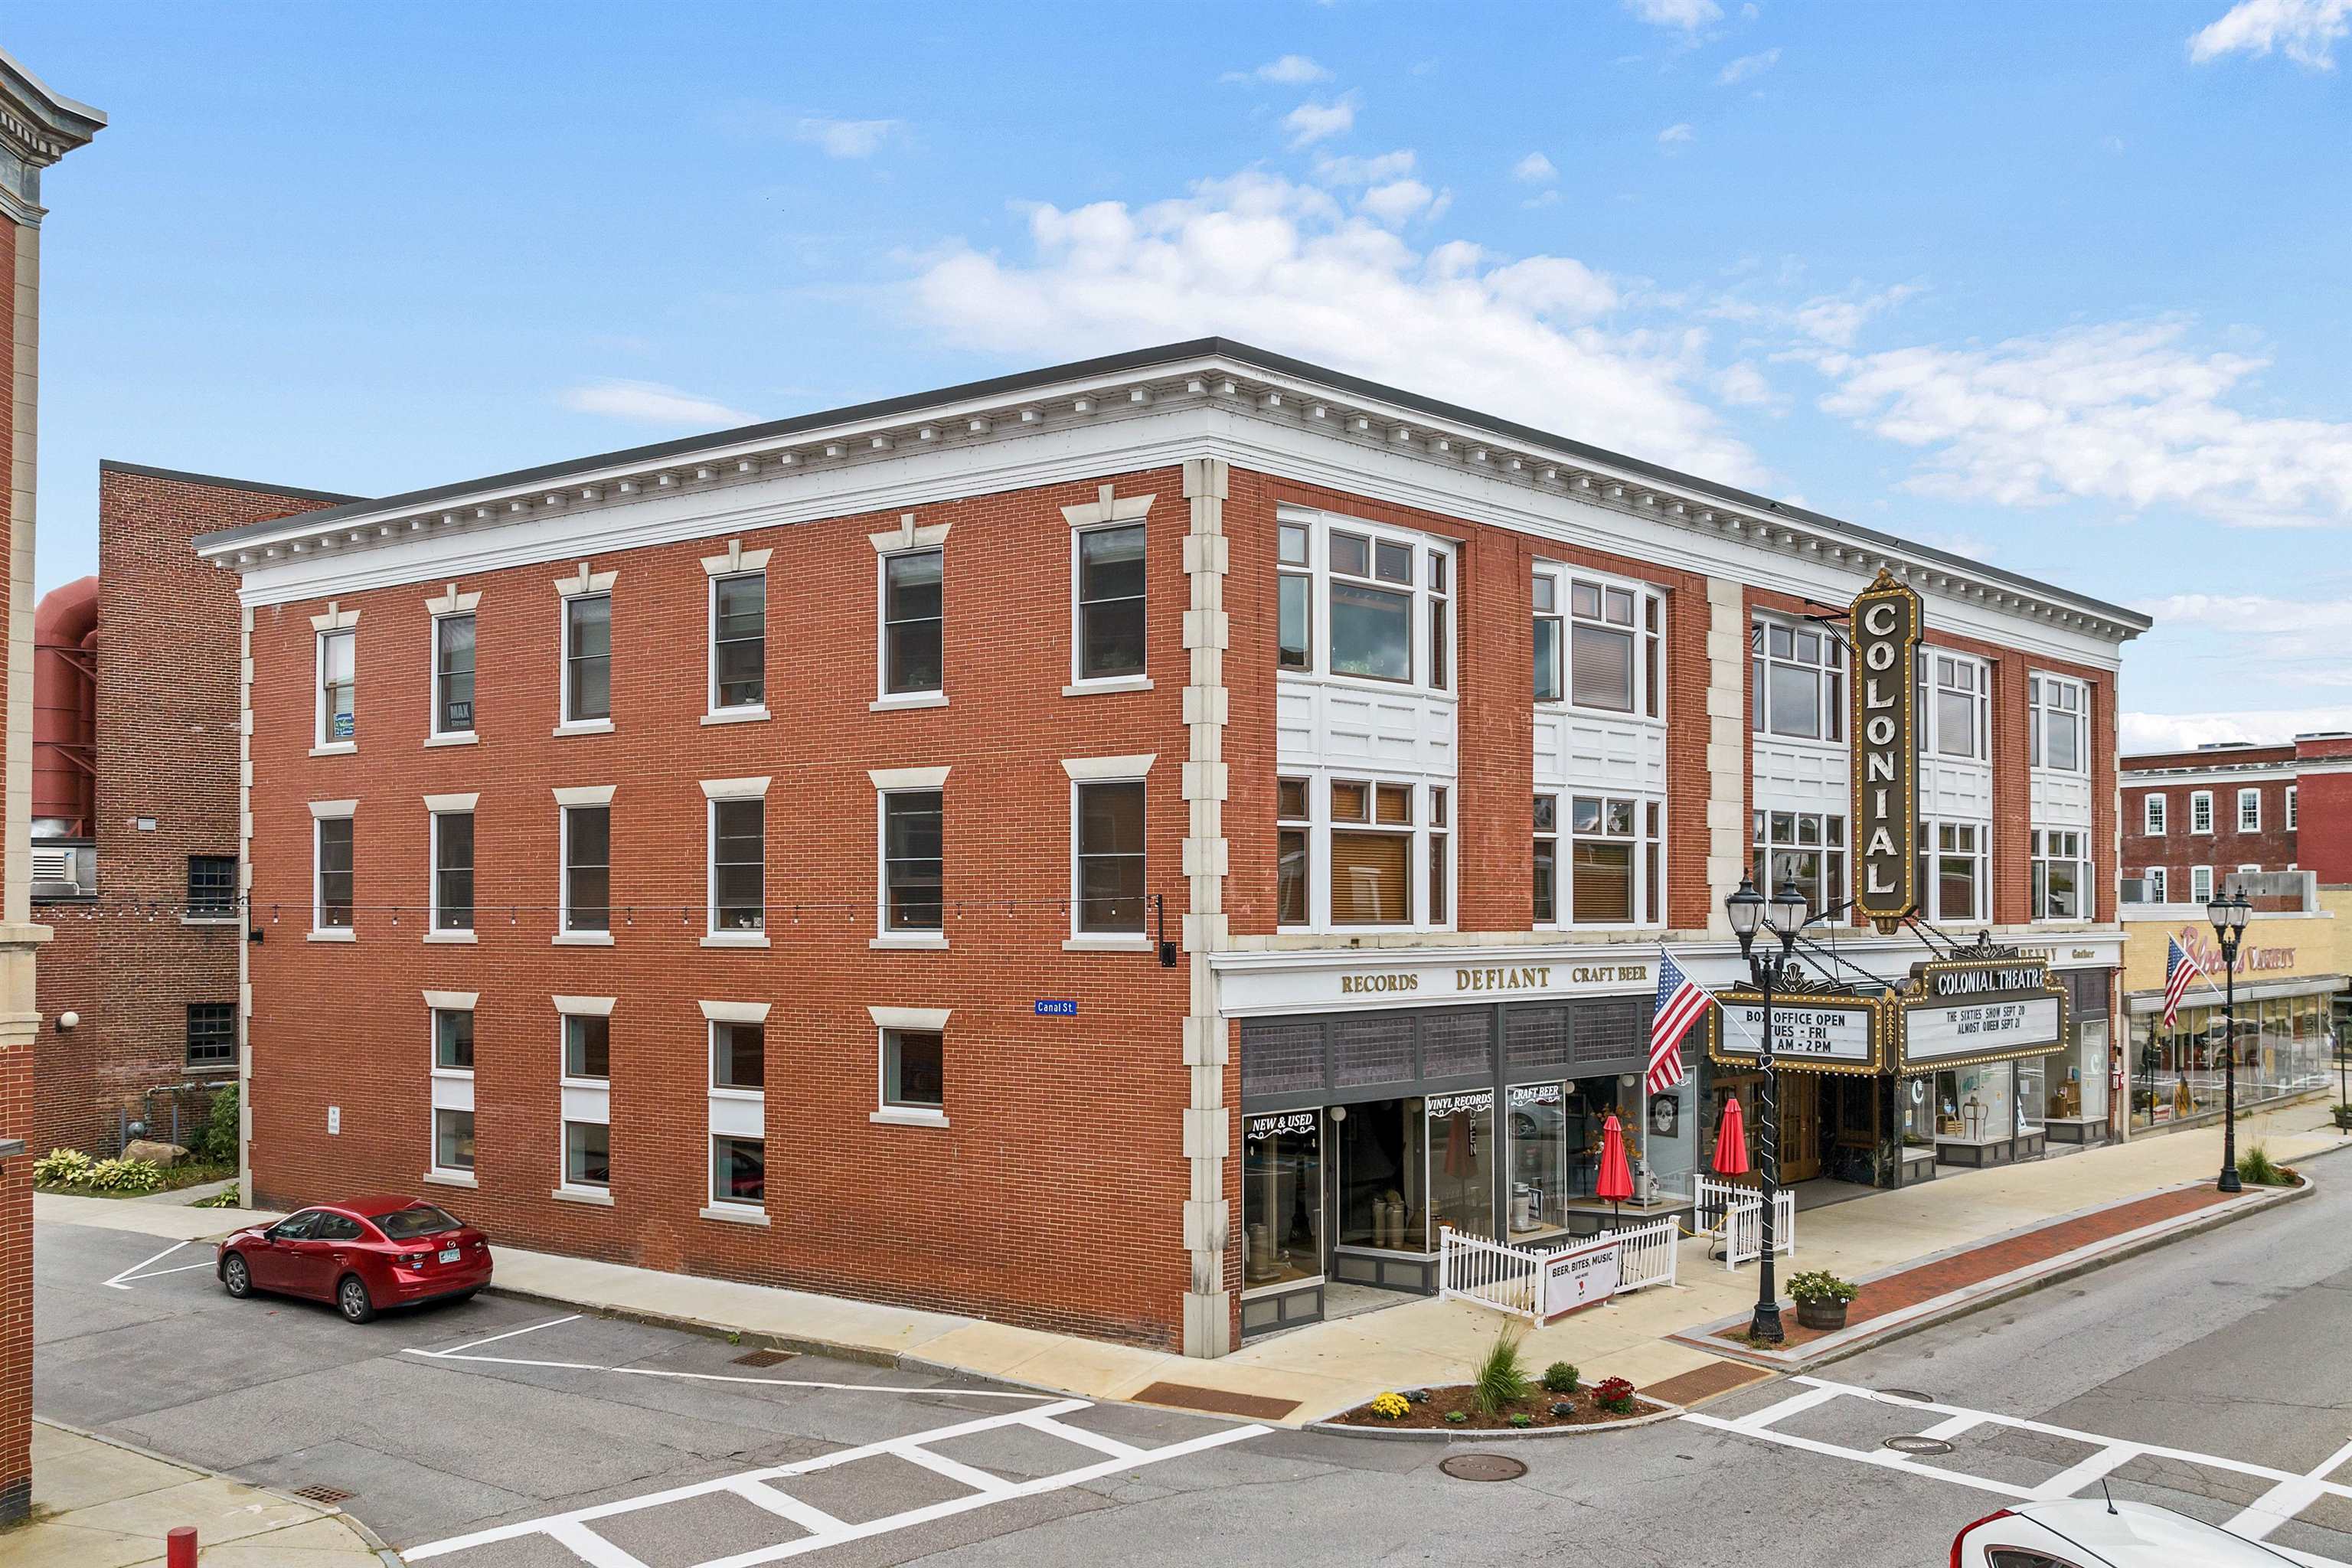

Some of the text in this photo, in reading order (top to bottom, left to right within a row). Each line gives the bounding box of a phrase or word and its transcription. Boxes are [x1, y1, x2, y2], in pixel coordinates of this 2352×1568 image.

[1864, 603, 1899, 894] COLONIAL
[1341, 965, 1648, 993] RECORDS DEFIANT CRAFT BEER
[1938, 967, 2044, 996] COLONIAL THEATRE
[1037, 1001, 1061, 1013] Canal
[1946, 1005, 2025, 1023] THE SIXTIES SHOW SEPT 20
[1774, 1012, 1811, 1025] OFFICE
[1816, 1014, 1845, 1027] OPEN
[1957, 1021, 1980, 1035] ALMOST
[1982, 1020, 1999, 1031] QUEEN
[2001, 1018, 2014, 1030] SEPT
[1771, 1024, 1795, 1037] UES
[1809, 1027, 1827, 1039] FRI
[1777, 1038, 1794, 1050] AM
[1513, 1085, 1560, 1100] CRAFT BEER
[1428, 1093, 1493, 1110] VINYL RECORDS
[1253, 1113, 1313, 1132] NEW & USED
[1552, 1252, 1613, 1278] BEER, BITES, MUSIC
